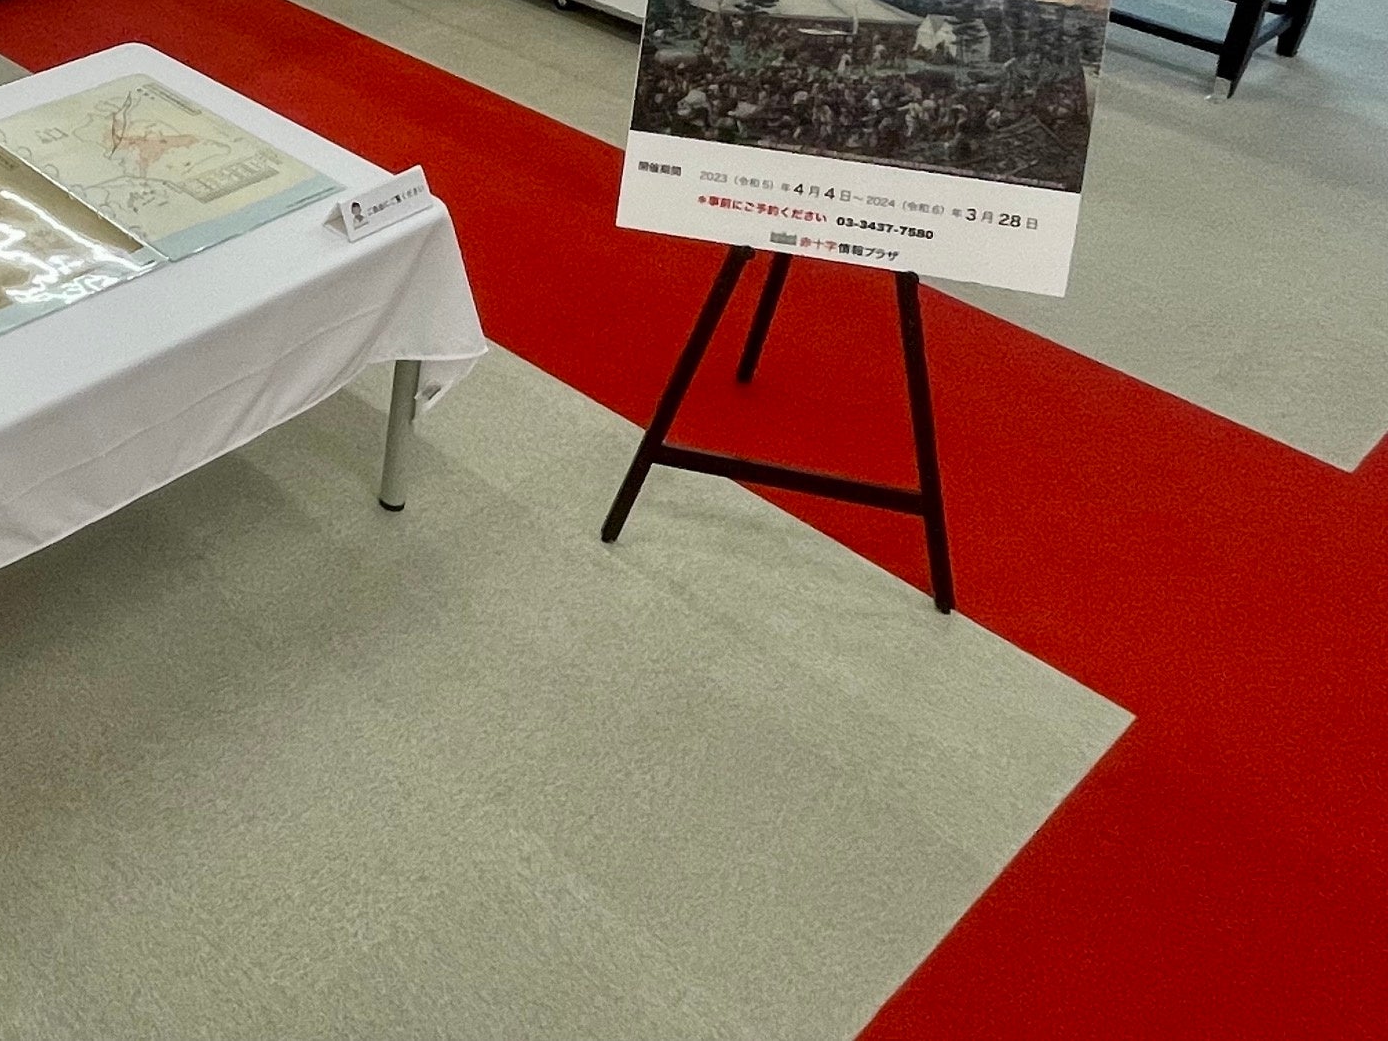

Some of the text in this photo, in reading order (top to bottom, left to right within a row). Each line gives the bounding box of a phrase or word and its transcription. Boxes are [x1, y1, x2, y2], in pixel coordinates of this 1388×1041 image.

[637, 160, 682, 178] 開催期間
[836, 216, 935, 240] 03-3437-7580
